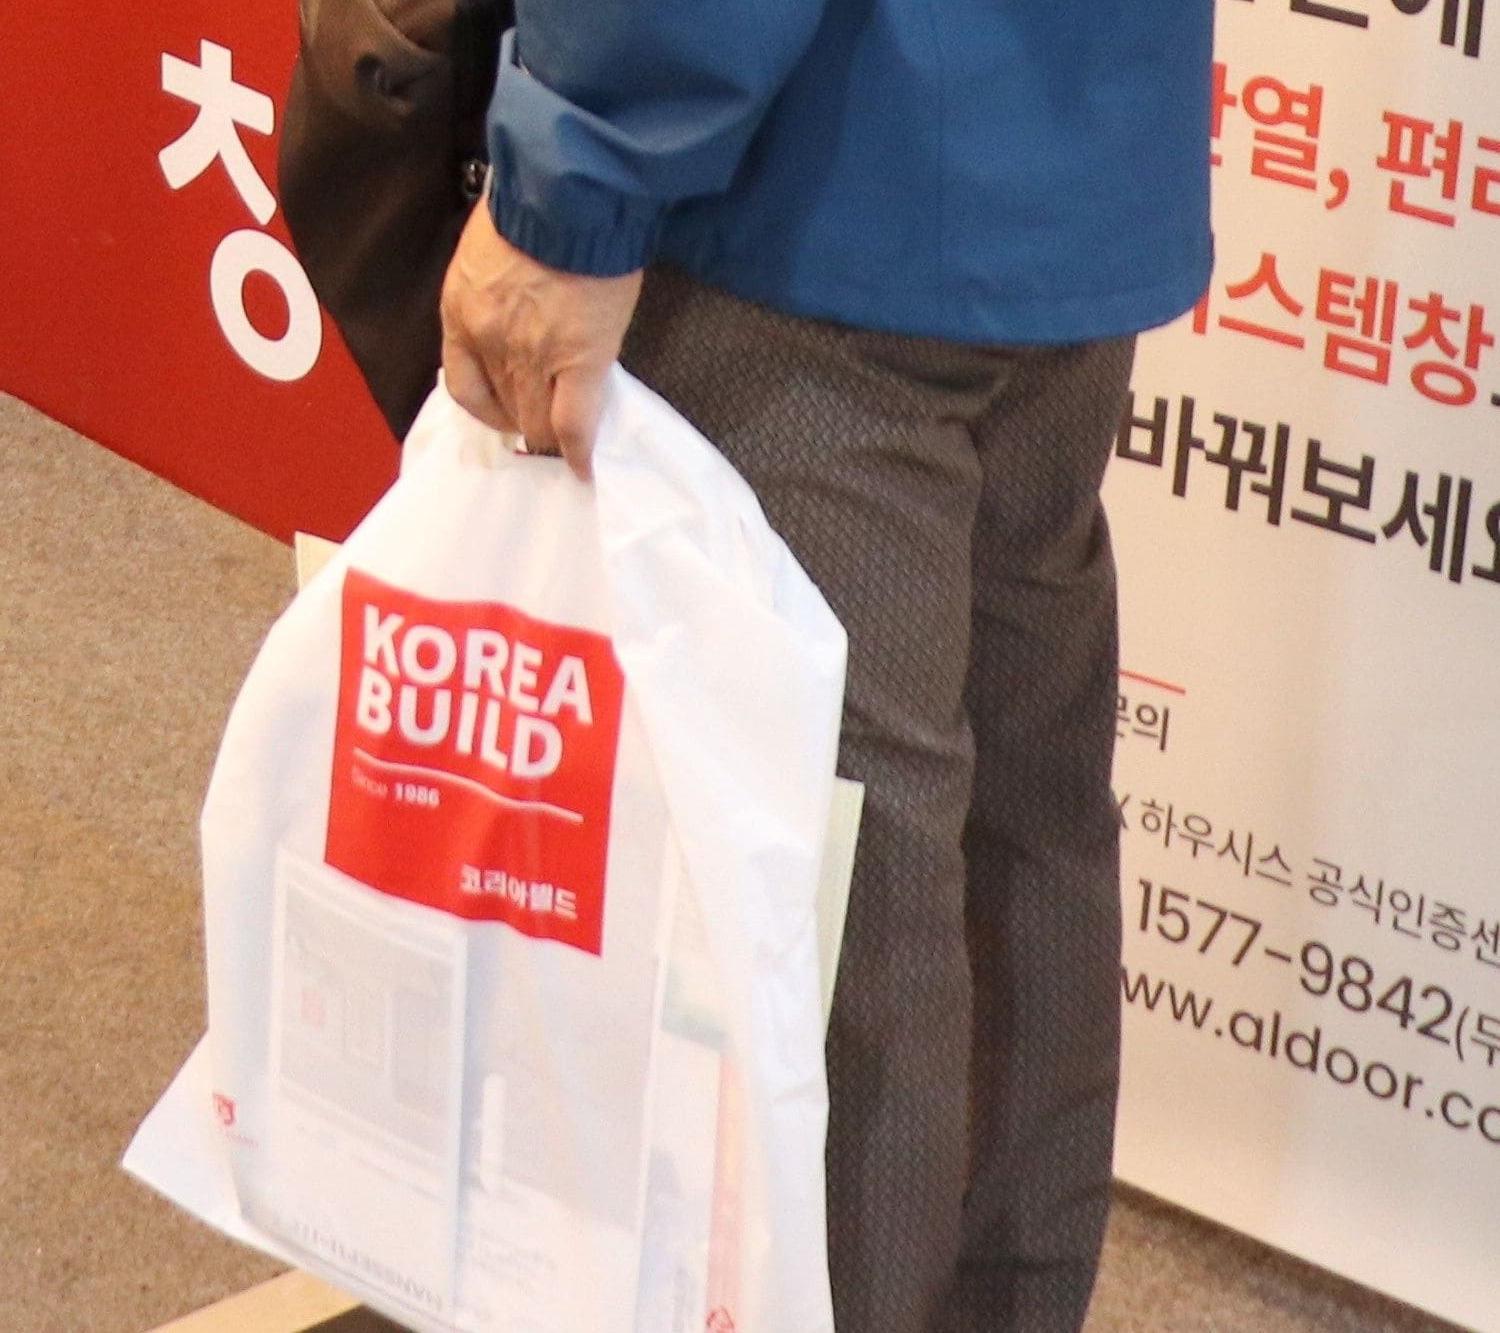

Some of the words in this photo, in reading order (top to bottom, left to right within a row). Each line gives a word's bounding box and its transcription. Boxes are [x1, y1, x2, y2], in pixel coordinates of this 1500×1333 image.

[1210, 62, 1350, 211] 열,
[356, 664, 563, 779] BUILD
[363, 603, 594, 726] KOREA
[1140, 797, 1293, 888] 하우시스
